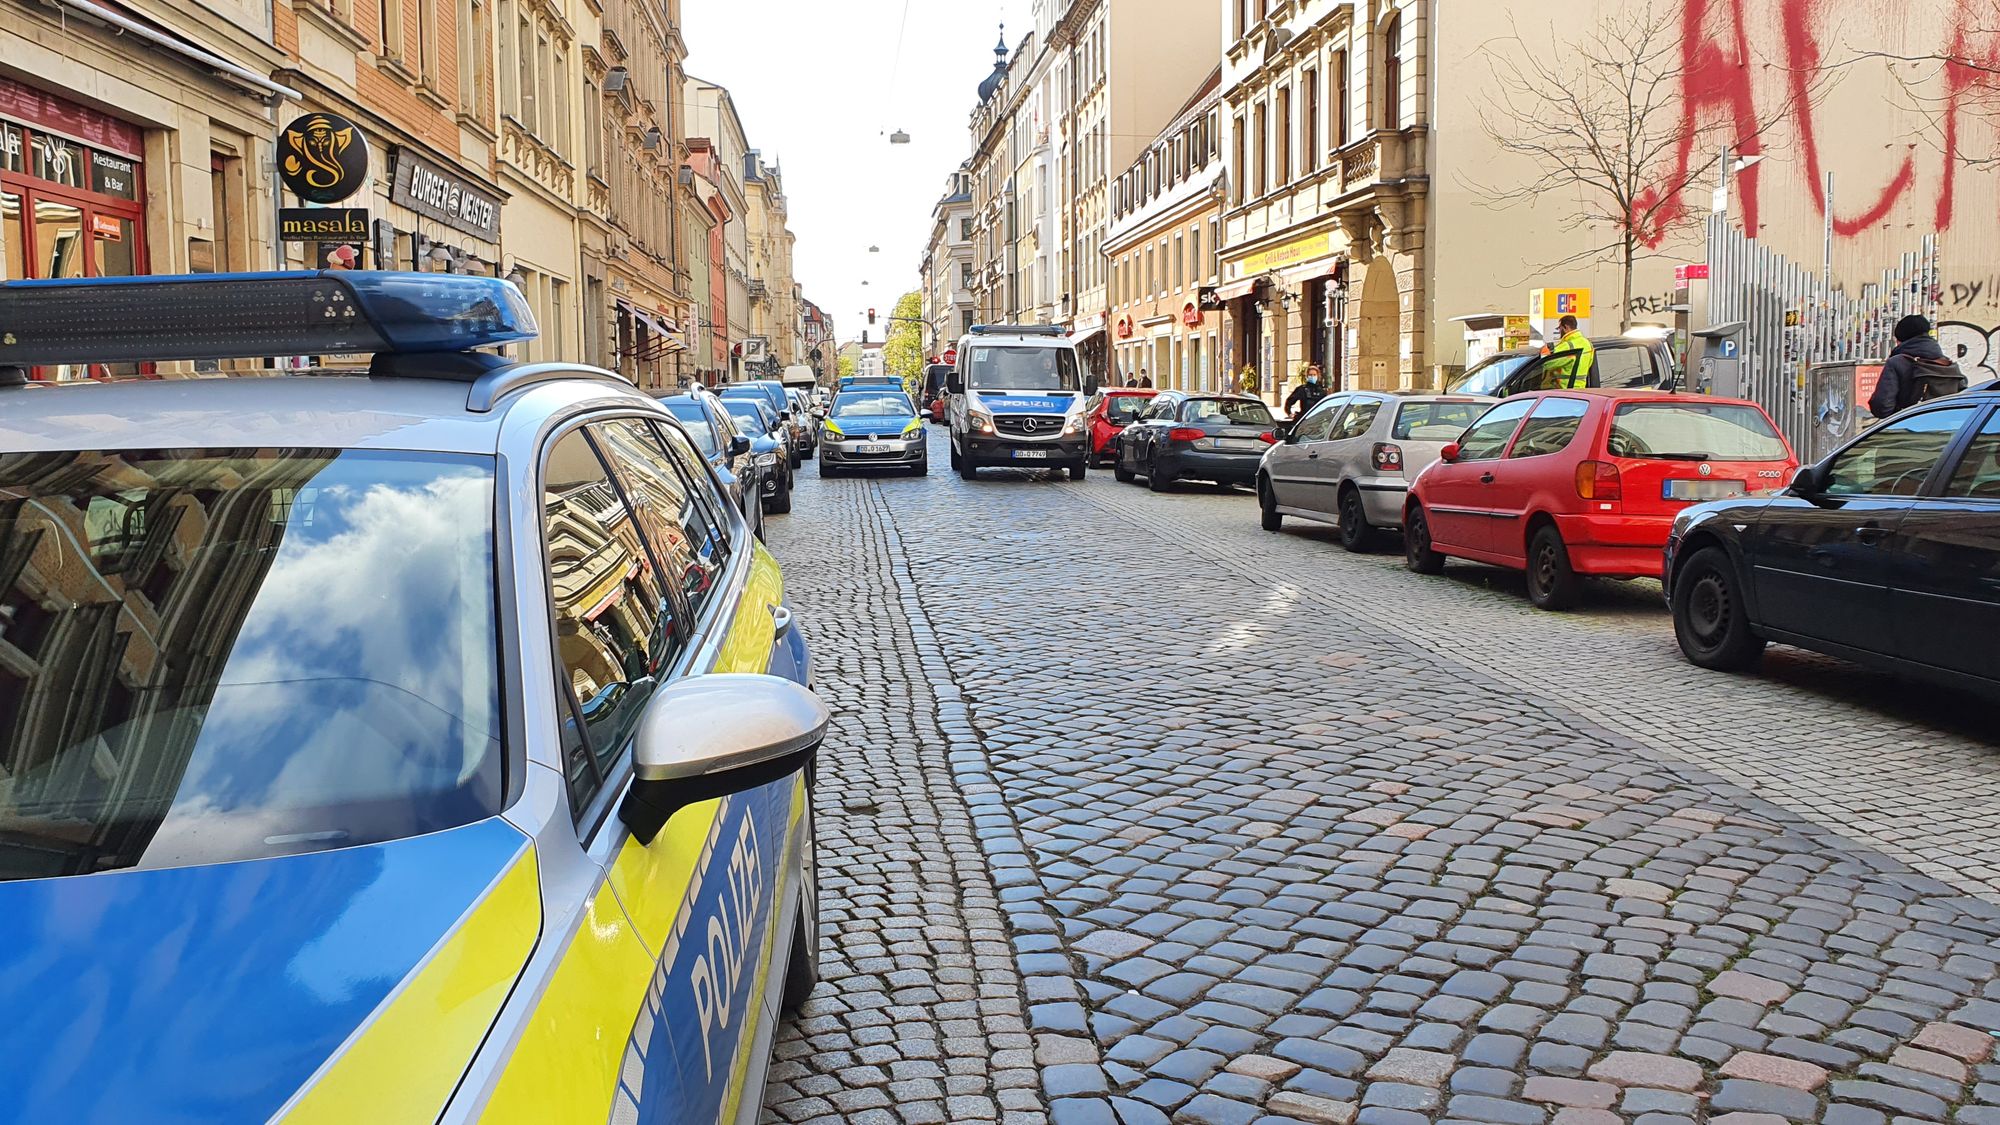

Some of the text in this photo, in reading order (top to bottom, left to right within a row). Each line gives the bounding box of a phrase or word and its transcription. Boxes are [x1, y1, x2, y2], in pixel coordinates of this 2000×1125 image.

[93, 152, 131, 174] Restaurant
[104, 176, 123, 191] & Bar
[410, 164, 493, 231] BURGER MEISTER
[283, 209, 366, 233] masala
[1725, 340, 1736, 356] P
[1002, 400, 1055, 408] POLIZEI
[690, 804, 762, 1084] POLIZEI
